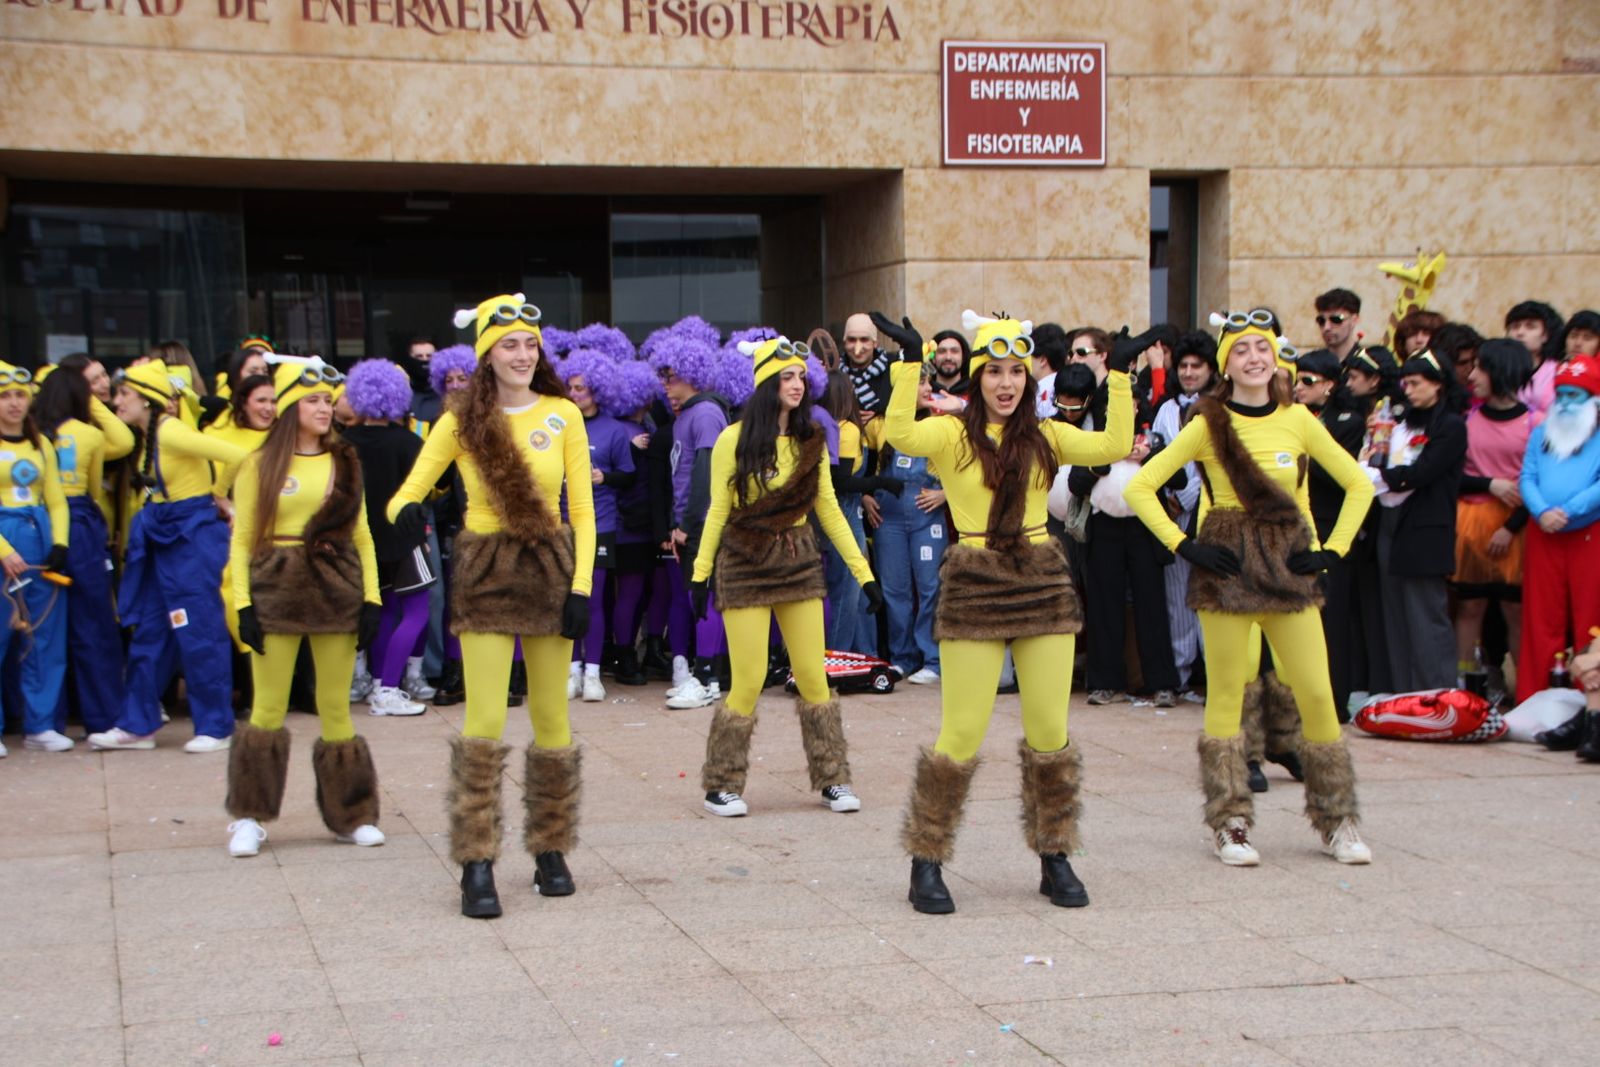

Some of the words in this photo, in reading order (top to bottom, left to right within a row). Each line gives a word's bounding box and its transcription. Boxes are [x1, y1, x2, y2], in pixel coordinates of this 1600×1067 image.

[567, 0, 590, 30] Y
[954, 52, 1095, 74] DEPARTAMENTO
[970, 75, 1080, 100] ENFERMERÍA
[1019, 107, 1031, 127] Y
[967, 134, 1083, 154] FISIOTERAPIA
